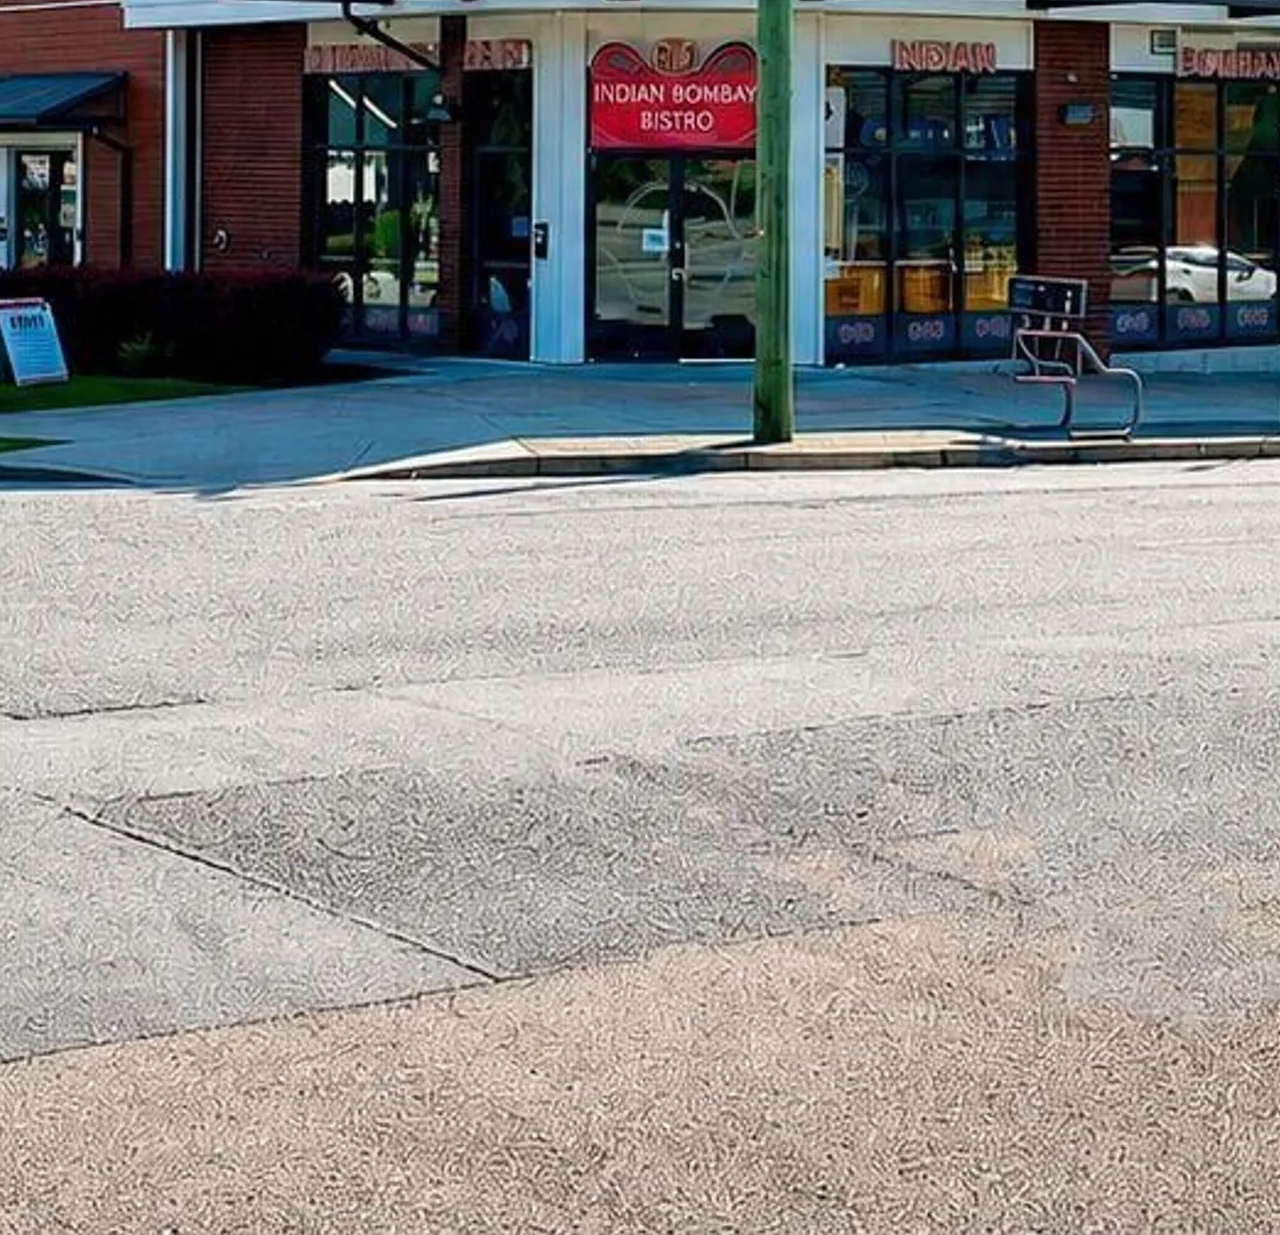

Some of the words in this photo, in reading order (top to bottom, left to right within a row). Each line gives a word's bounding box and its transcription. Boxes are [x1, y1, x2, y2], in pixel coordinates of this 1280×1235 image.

[891, 39, 997, 74] INDIAN
[594, 83, 664, 104] INDIAN
[672, 83, 757, 105] BOMBAY
[640, 110, 715, 132] BISTRO
